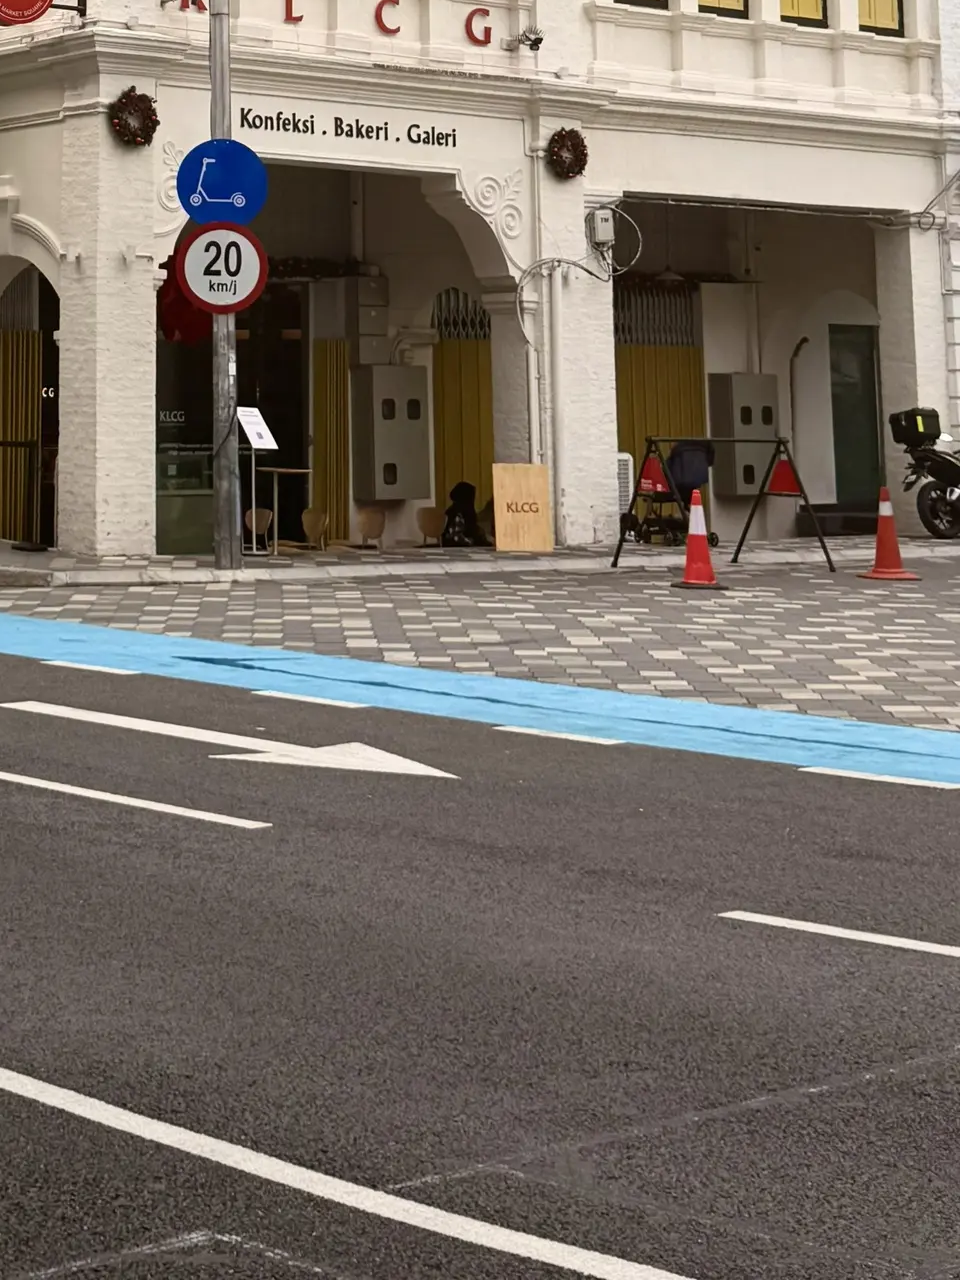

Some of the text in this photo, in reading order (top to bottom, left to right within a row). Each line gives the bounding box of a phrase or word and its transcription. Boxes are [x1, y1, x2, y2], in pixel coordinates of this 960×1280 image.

[240, 107, 315, 135] Konfeksi
[334, 116, 389, 141] Bakeri
[407, 123, 457, 148] Galeri
[203, 240, 242, 277] 20
[208, 279, 237, 296] km/j
[159, 410, 185, 422] KLCG
[506, 501, 539, 513] KLCG
